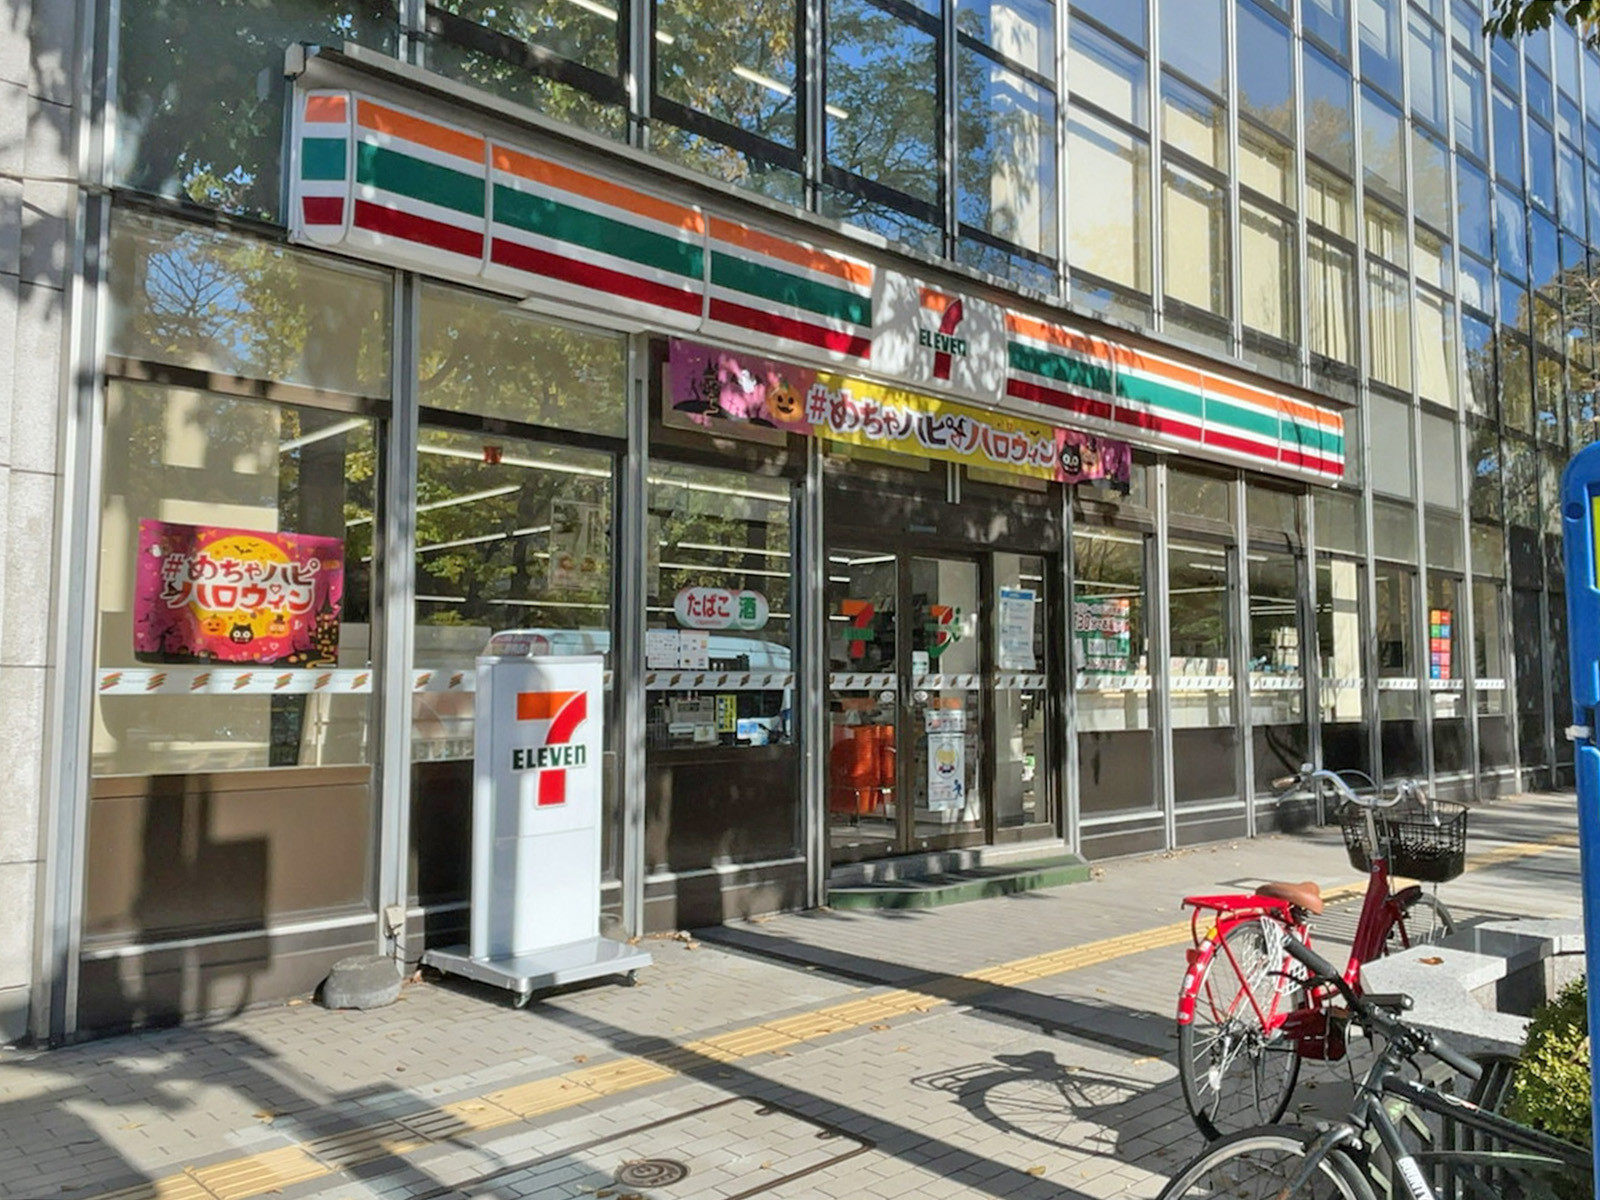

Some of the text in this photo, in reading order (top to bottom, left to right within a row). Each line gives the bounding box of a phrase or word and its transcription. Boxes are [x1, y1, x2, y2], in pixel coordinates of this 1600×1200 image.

[164, 581, 314, 612] ハロウィン
[687, 593, 757, 619] たばこ 酒
[516, 690, 588, 807] 7
